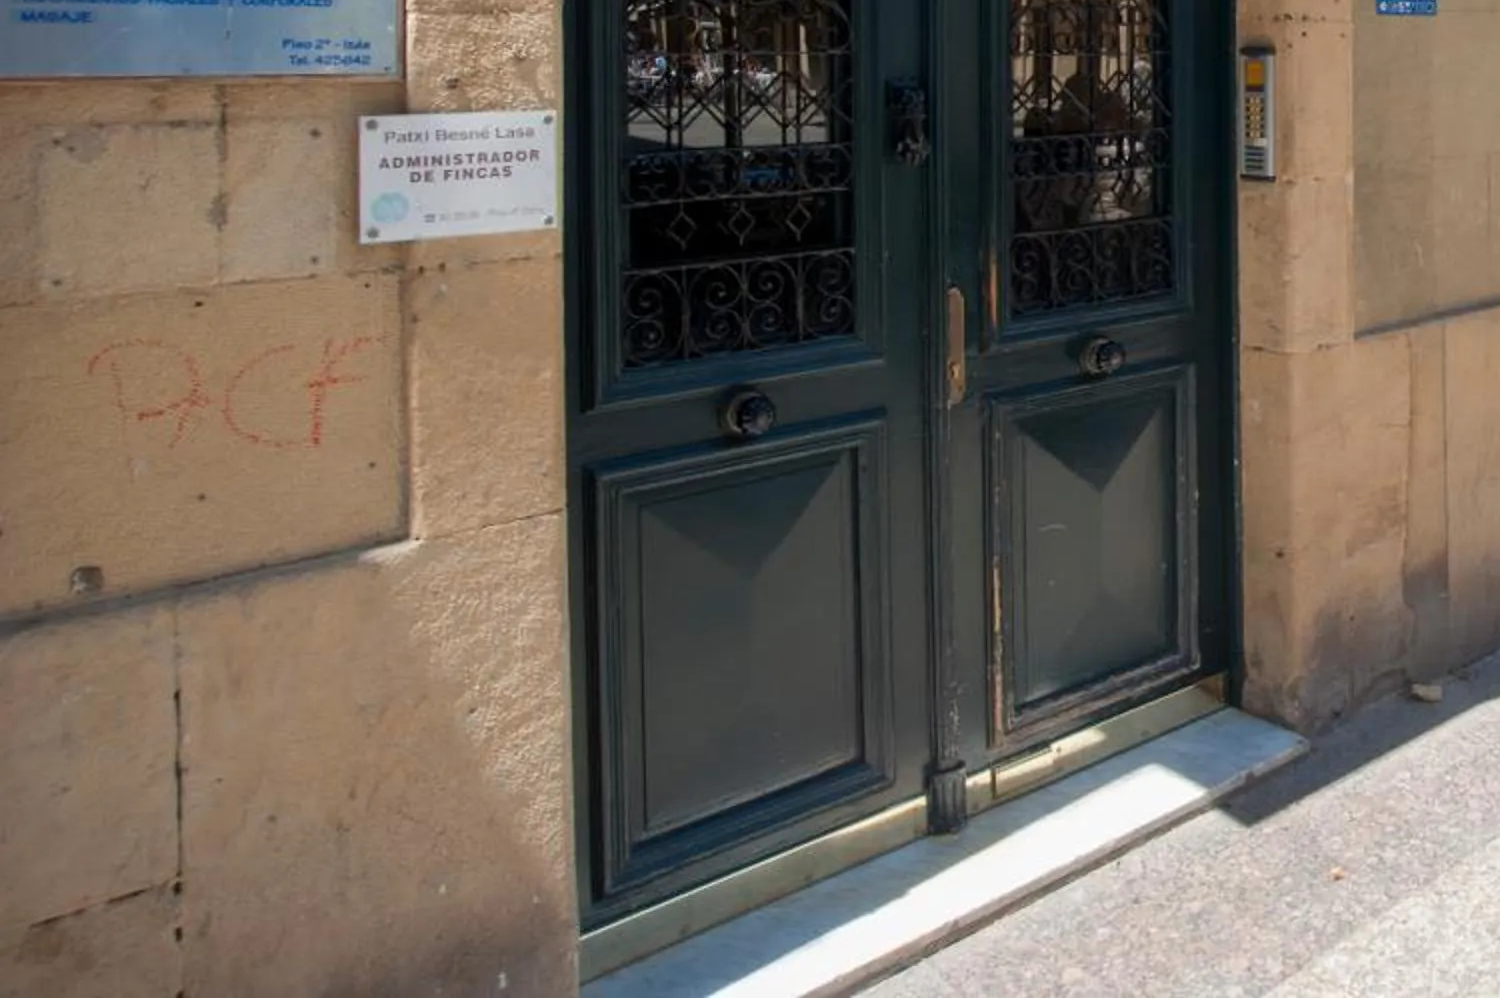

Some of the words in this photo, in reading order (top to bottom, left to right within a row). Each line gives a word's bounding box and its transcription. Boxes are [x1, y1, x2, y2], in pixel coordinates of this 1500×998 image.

[384, 131, 429, 144] Patxi
[495, 126, 536, 140] Lasa
[379, 149, 541, 170] ADMINISTRADOR
[409, 170, 435, 183] DE
[443, 166, 513, 182] FINCAS
